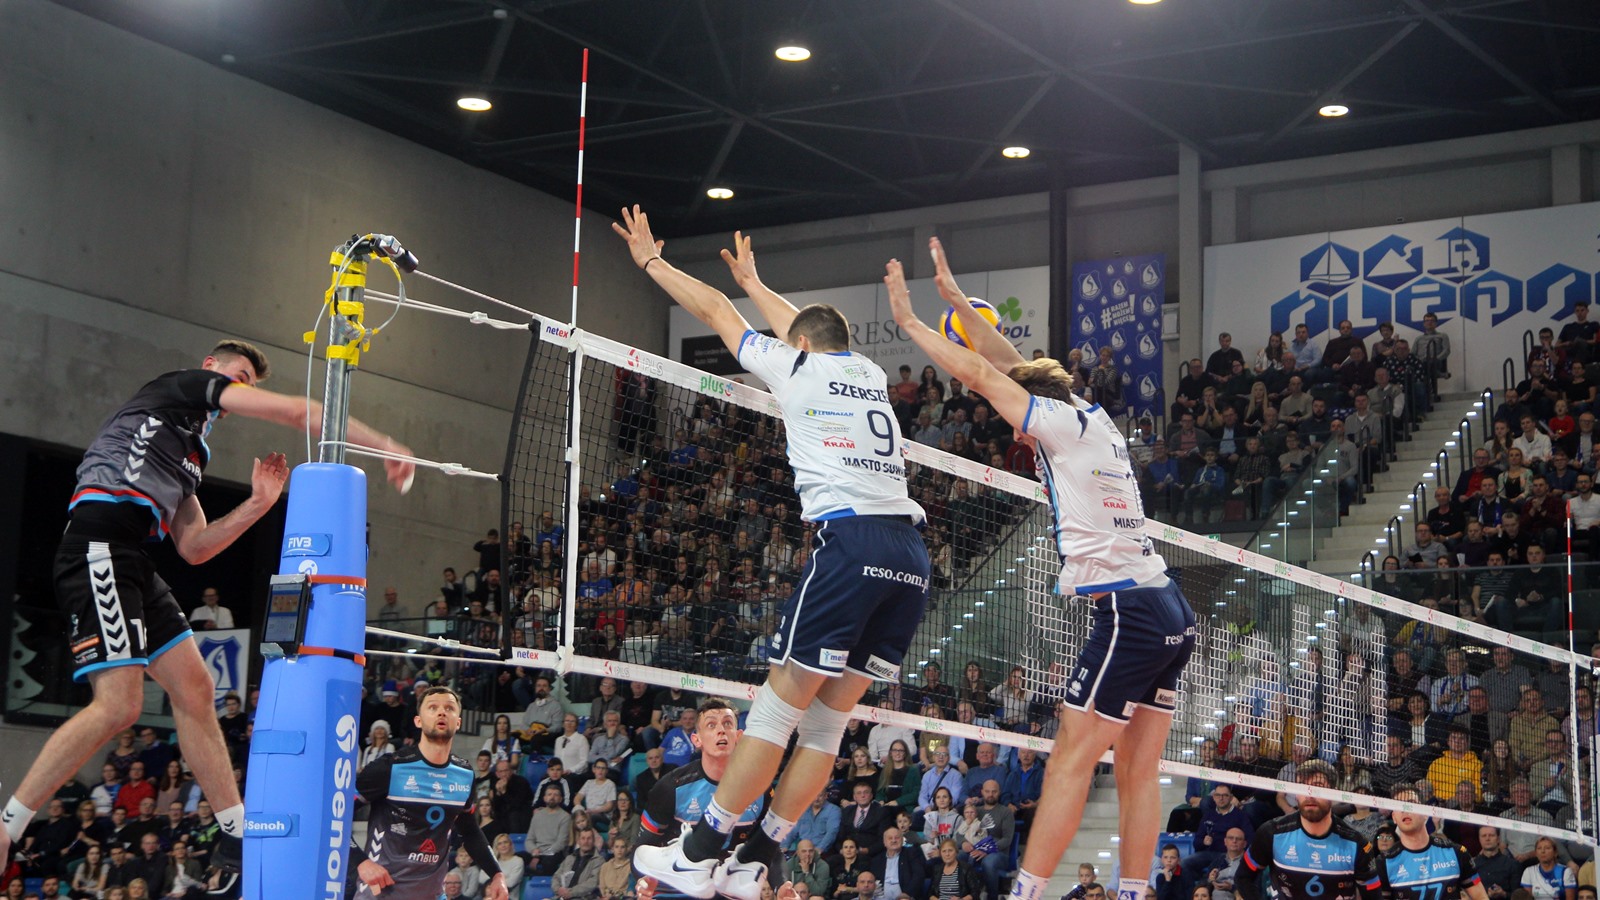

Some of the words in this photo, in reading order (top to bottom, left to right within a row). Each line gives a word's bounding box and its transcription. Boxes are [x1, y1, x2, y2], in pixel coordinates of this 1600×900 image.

[546, 325, 569, 338] netex
[700, 375, 724, 395] plus
[829, 381, 890, 404] SZERSZE
[867, 409, 895, 457] 9
[823, 441, 856, 449] KRAM
[1104, 501, 1128, 509] KRAM
[288, 536, 313, 548] FIVB
[516, 649, 539, 660] netex
[681, 674, 698, 688] plus
[425, 806, 445, 830] 9
[247, 820, 285, 830] Senoh
[1432, 861, 1449, 871] plus
[1305, 875, 1324, 897] 6
[1411, 882, 1443, 900] 77
